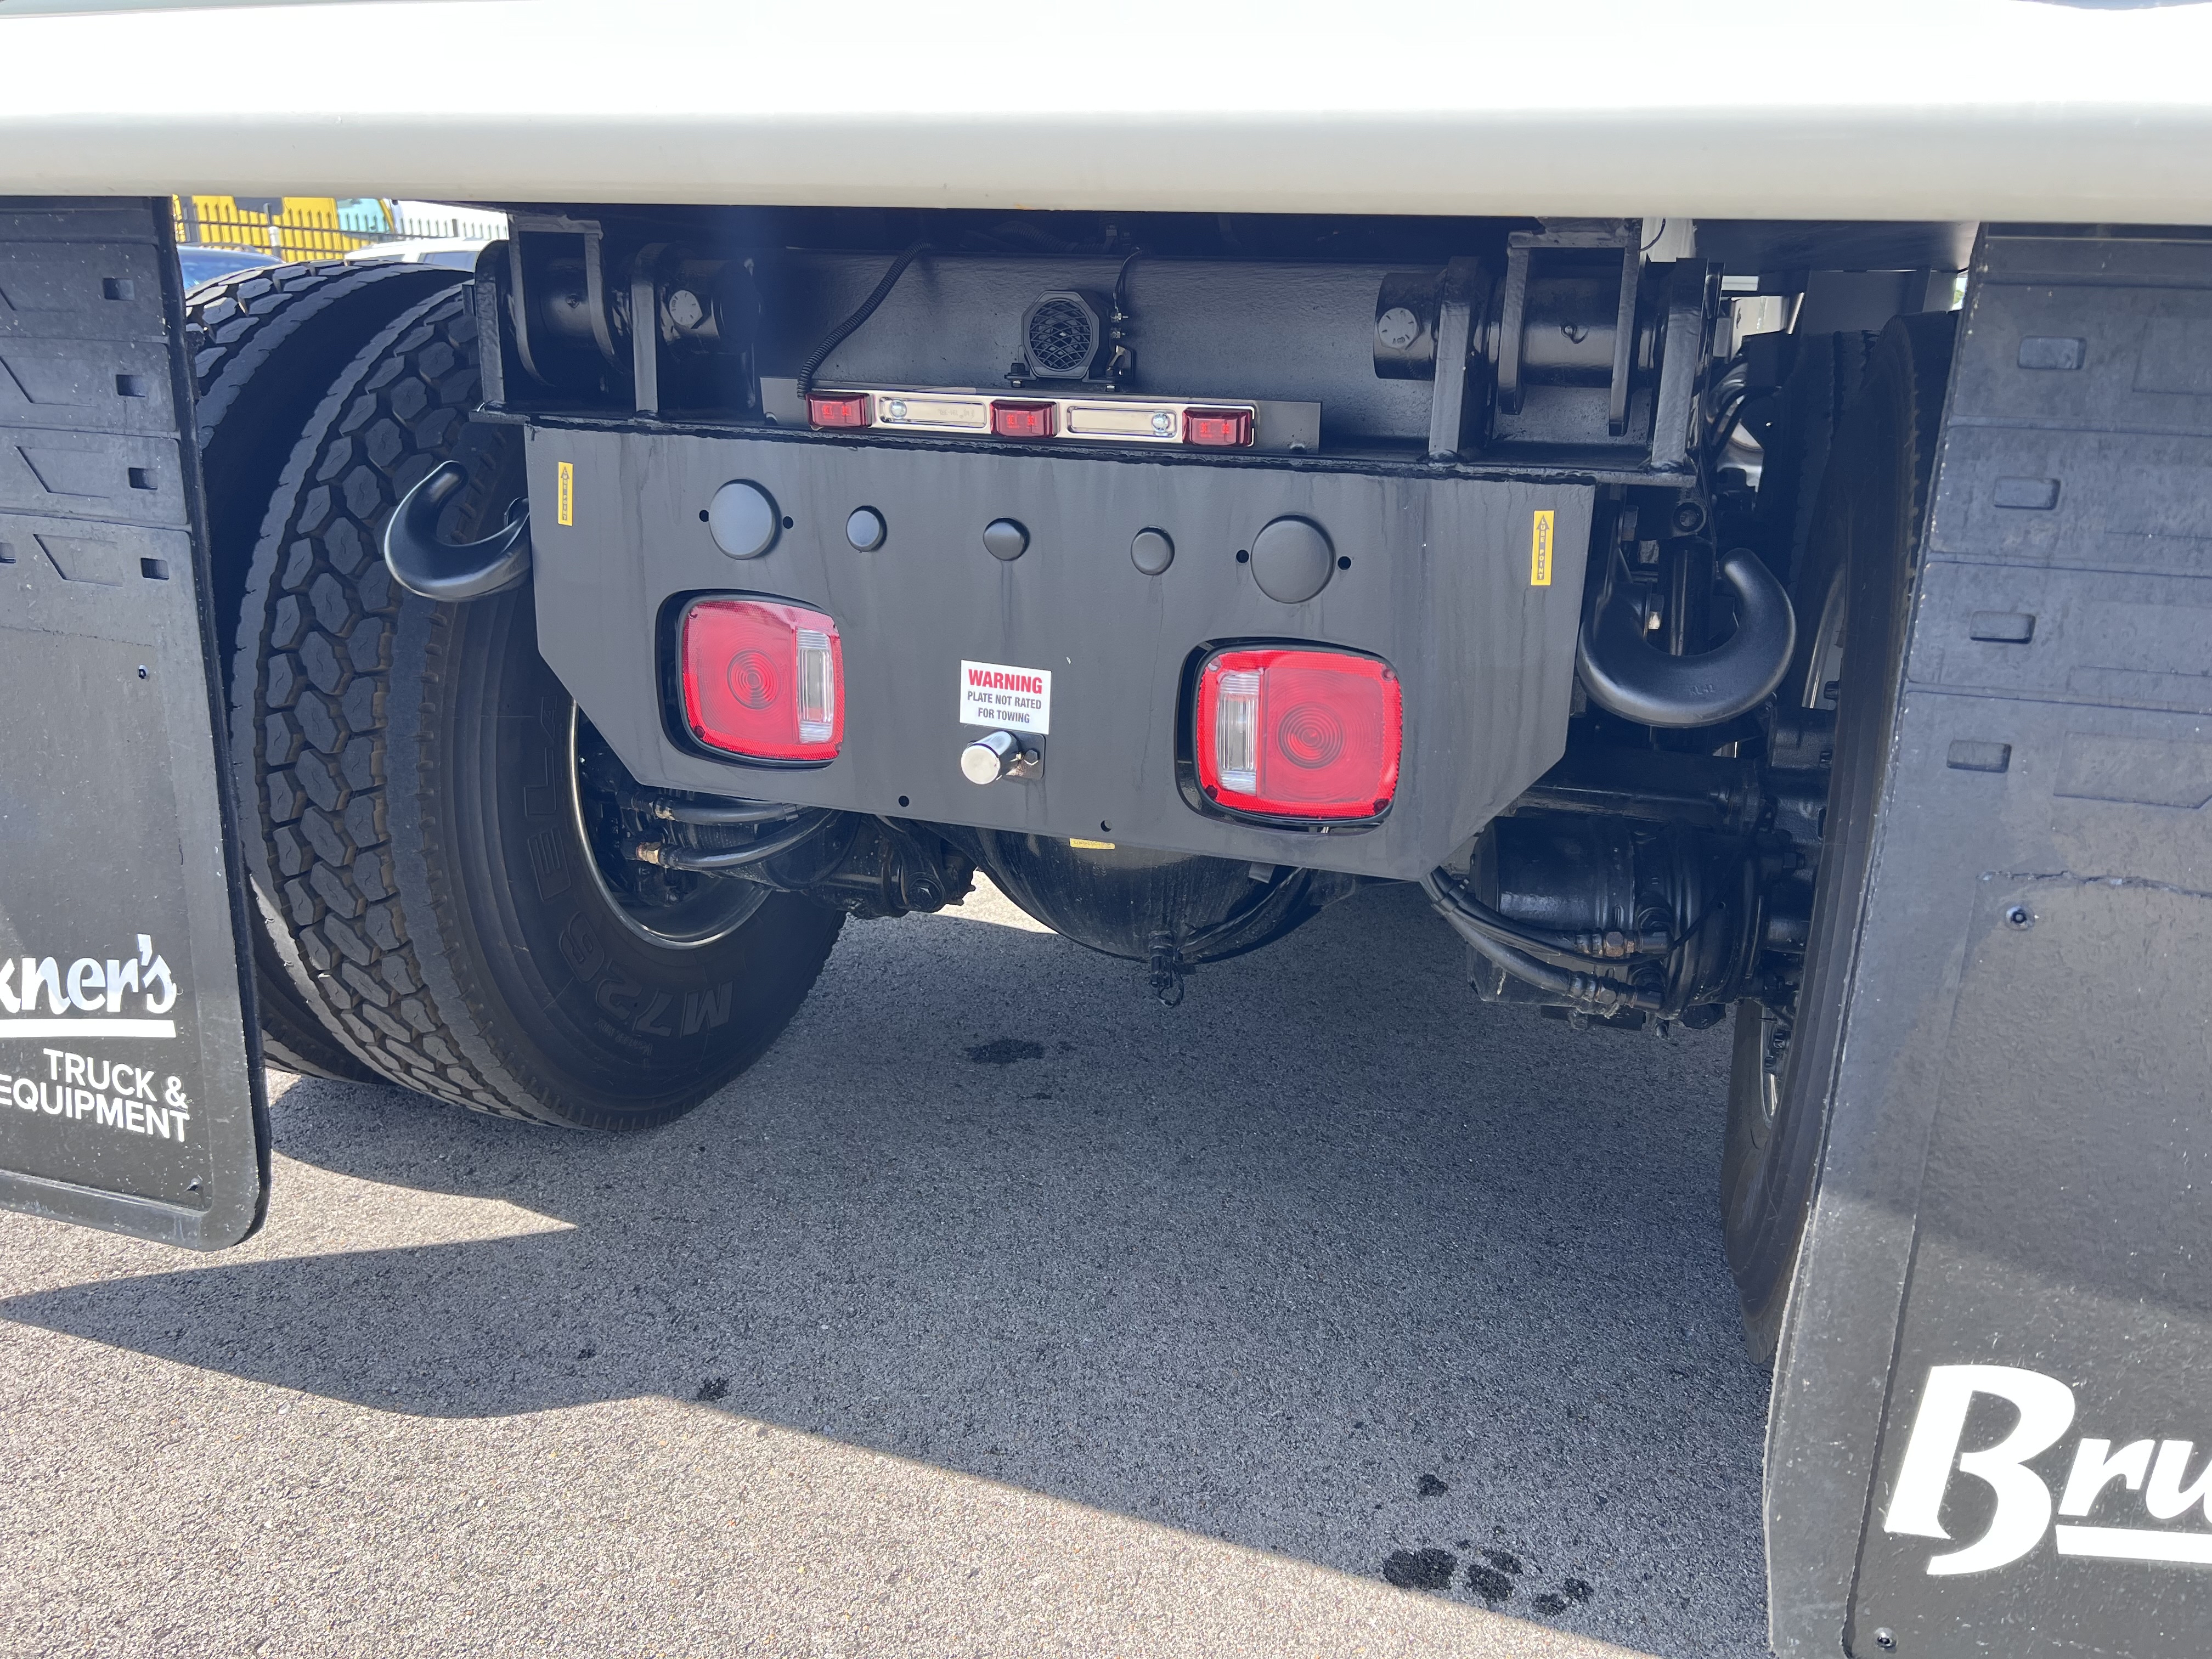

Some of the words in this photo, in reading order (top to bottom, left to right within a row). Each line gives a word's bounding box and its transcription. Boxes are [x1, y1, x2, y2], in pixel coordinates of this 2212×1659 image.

[967, 691, 992, 703] PLATE
[995, 695, 1012, 706] NOT
[1014, 697, 1042, 709] RATED
[968, 669, 1042, 694] WARNING
[978, 707, 995, 719] FOR
[996, 710, 1030, 723] TOWING
[560, 911, 733, 1038] M726
[43, 1048, 157, 1102] TRUCK
[165, 1076, 189, 1109] &
[0, 1074, 190, 1142] EQUIPMENT
